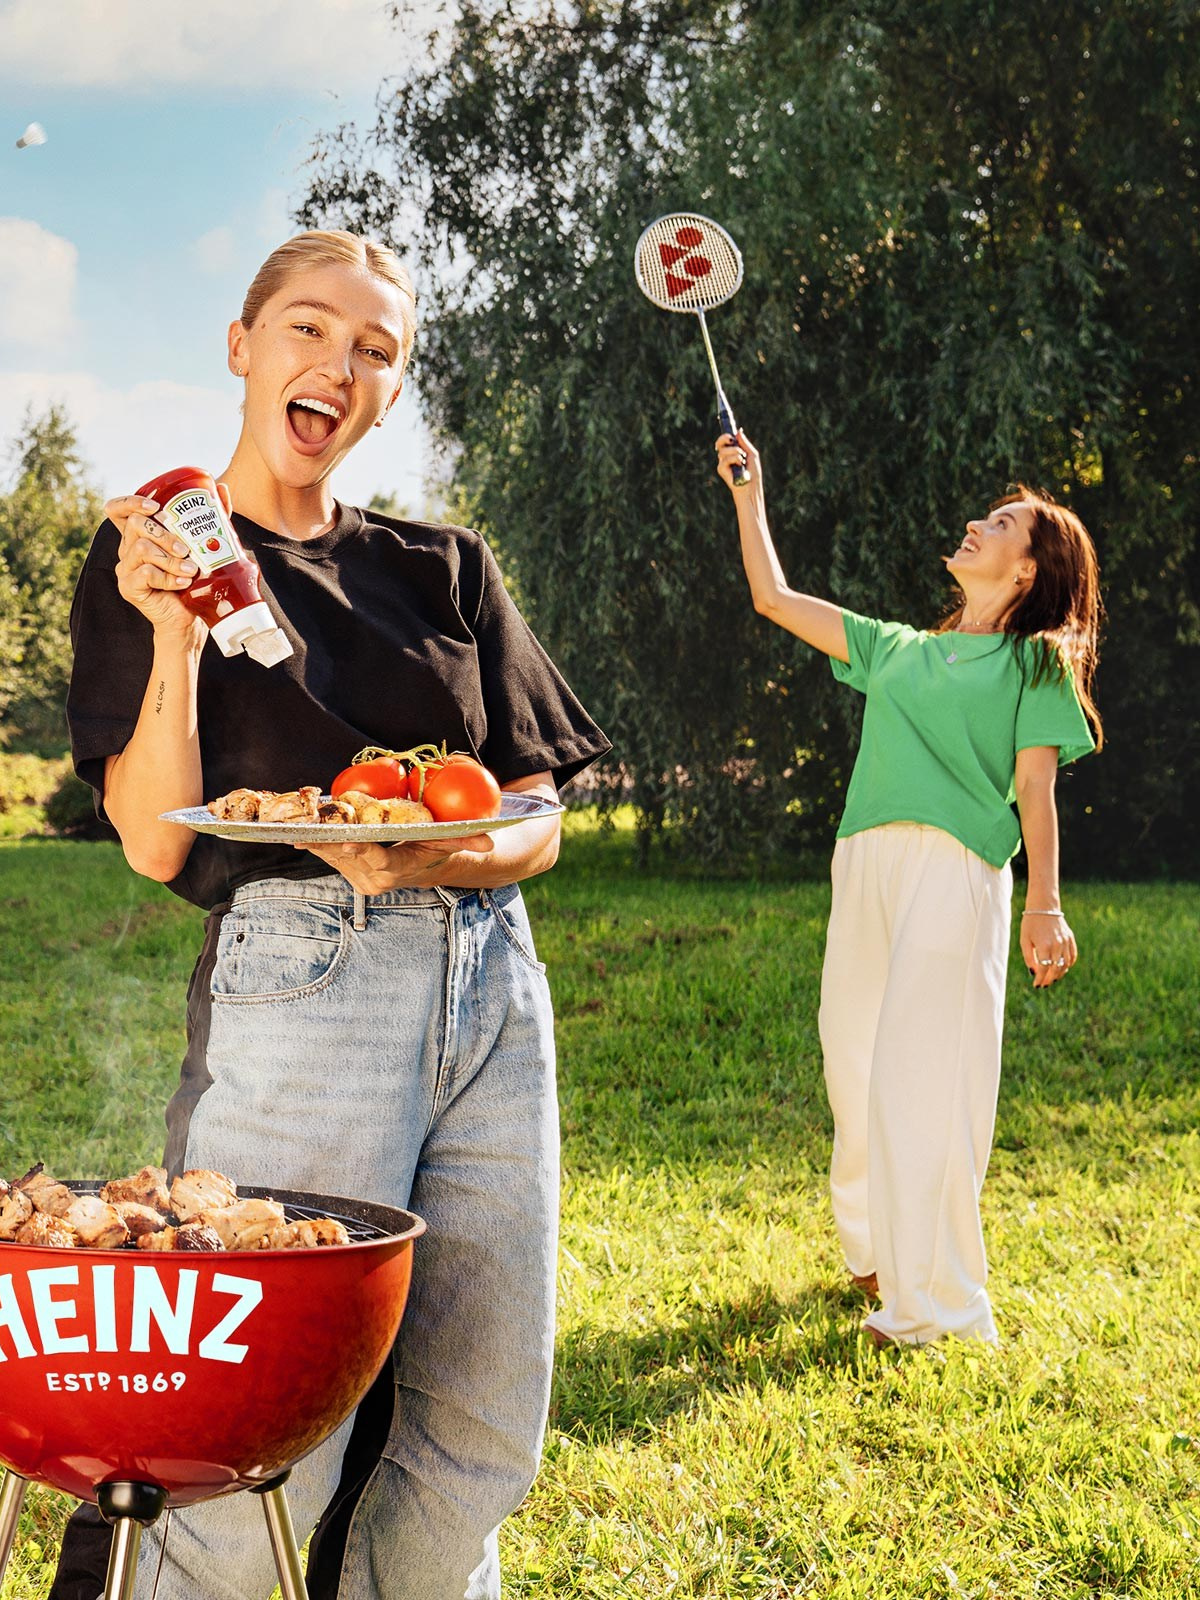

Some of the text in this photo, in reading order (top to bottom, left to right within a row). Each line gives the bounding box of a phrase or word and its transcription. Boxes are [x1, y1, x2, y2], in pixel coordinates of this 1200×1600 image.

[175, 497, 206, 515] HEINZ
[178, 510, 218, 532] ТОМАТНЫЙ
[190, 521, 218, 538] КЕТЧУП
[155, 681, 166, 715] ALL CASH
[118, 1371, 187, 1394] 1869
